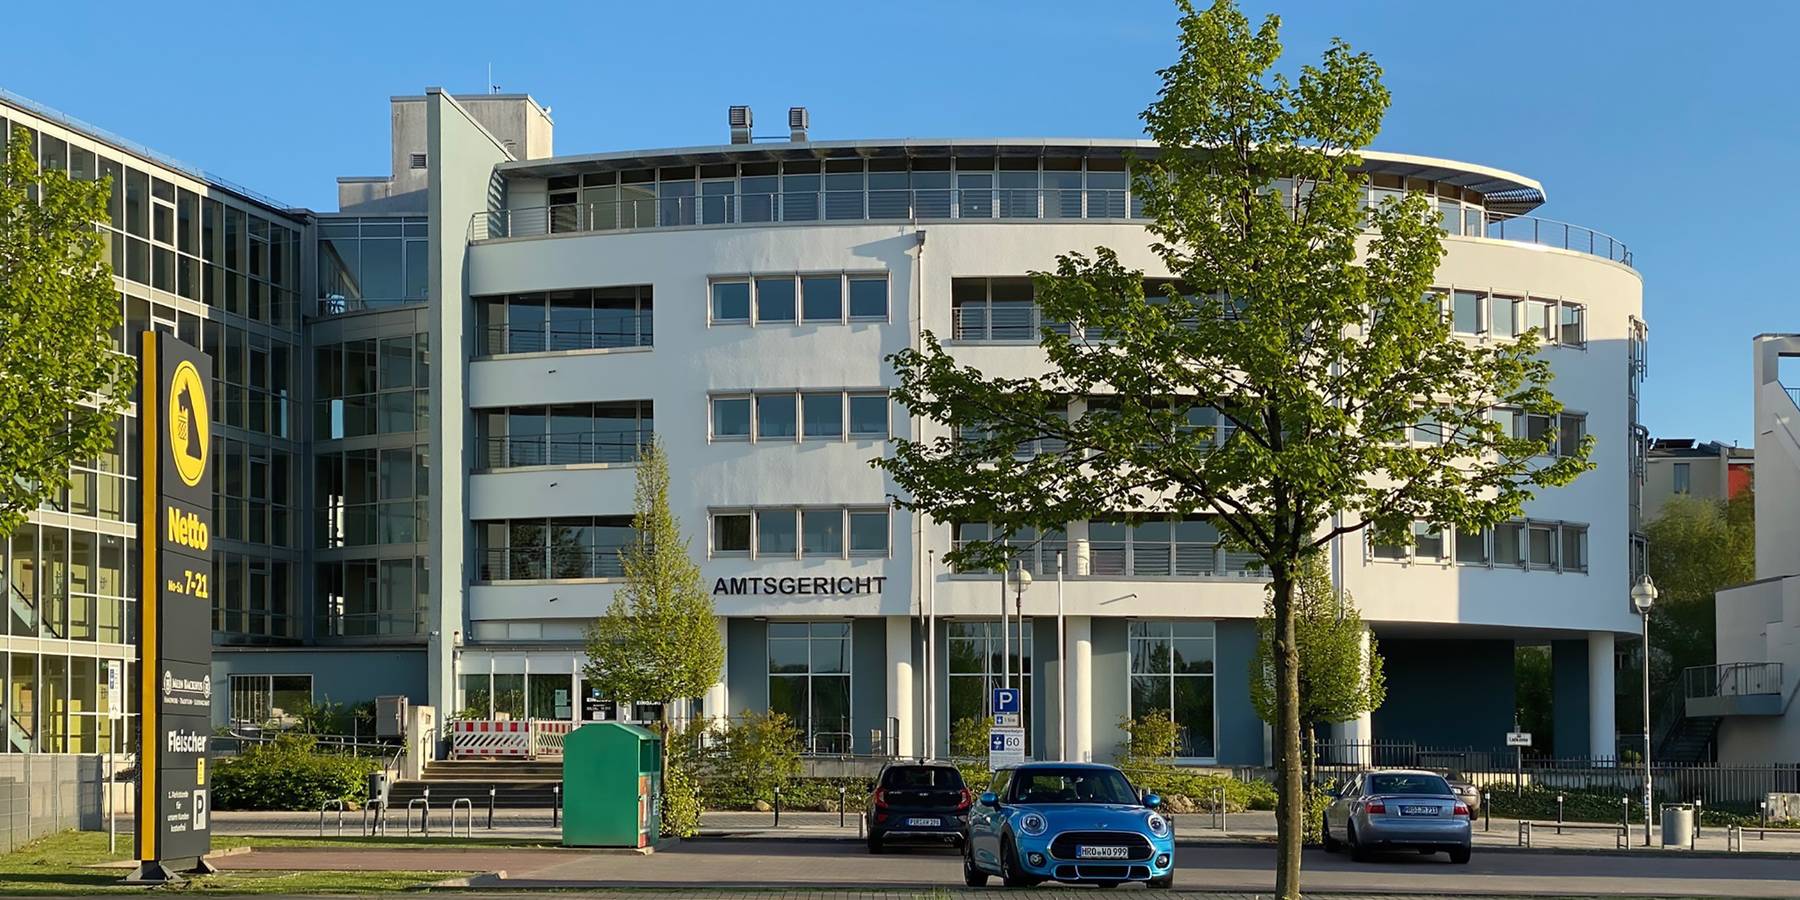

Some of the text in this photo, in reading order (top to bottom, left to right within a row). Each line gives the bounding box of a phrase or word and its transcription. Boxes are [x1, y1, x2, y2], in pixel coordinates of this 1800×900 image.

[168, 506, 208, 551] Netto
[167, 570, 208, 598] Mo-Sa 7-21
[713, 576, 887, 595] AMTSGERICHT
[1000, 691, 1013, 710] P
[168, 729, 206, 753] Fleischer
[1006, 737, 1020, 747] 60
[196, 794, 204, 825] P
[1082, 847, 1128, 856] HRO WO 999
